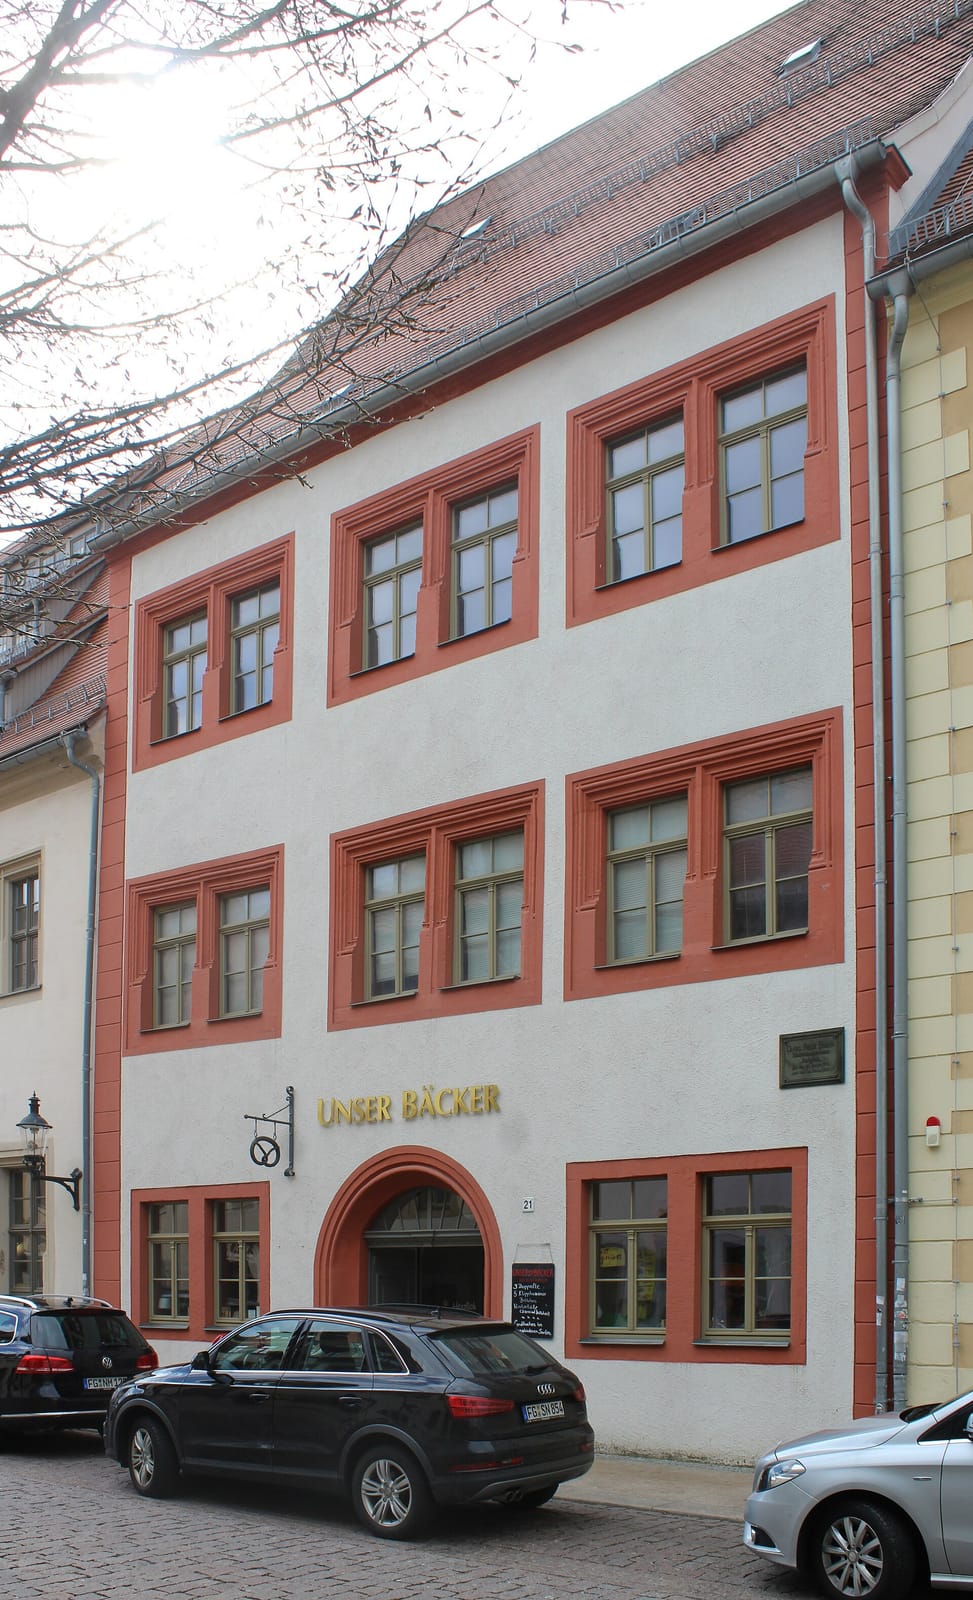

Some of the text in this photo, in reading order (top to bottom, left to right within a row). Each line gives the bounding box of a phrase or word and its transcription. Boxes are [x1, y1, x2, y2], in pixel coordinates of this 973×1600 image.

[317, 1084, 501, 1127] UNSER BÄCKER
[523, 1200, 533, 1210] 21
